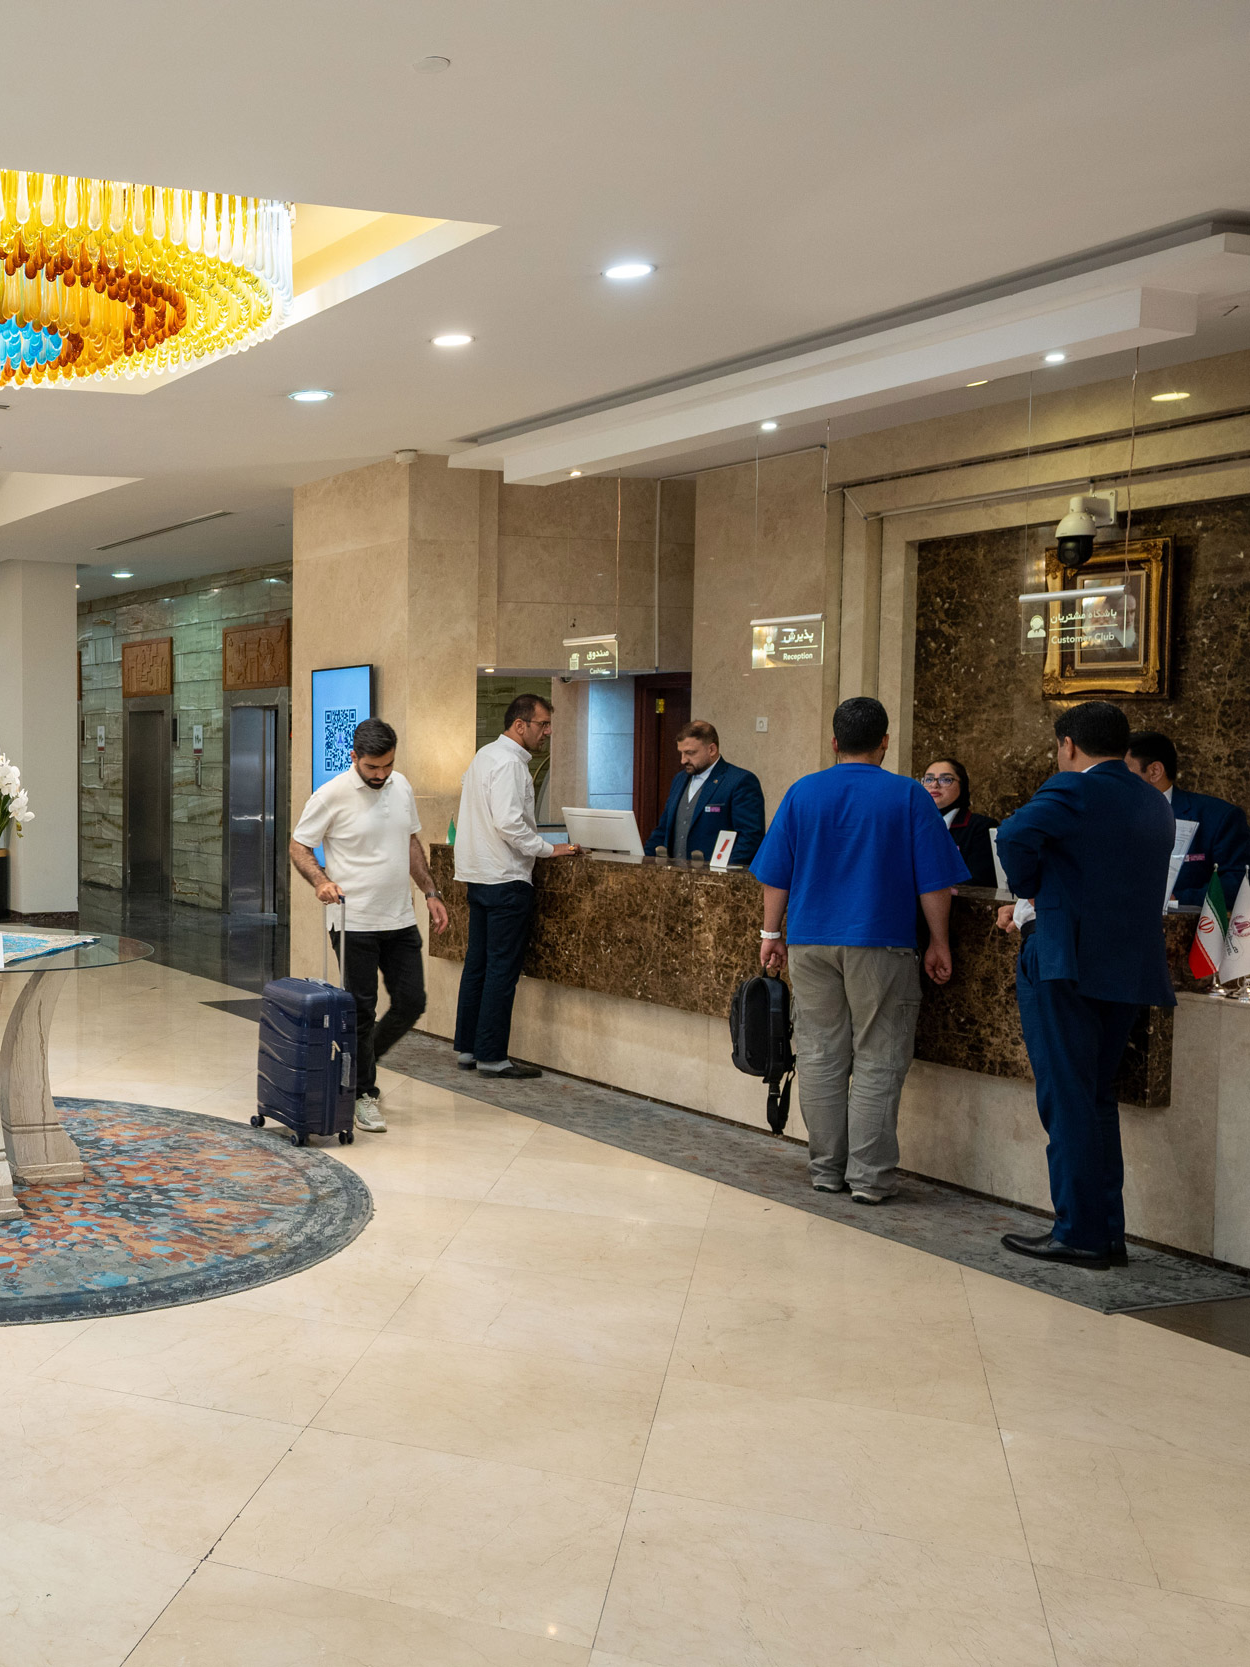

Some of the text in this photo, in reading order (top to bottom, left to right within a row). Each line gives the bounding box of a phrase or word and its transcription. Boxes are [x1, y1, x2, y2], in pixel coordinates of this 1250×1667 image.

[1049, 611, 1086, 624] مشتریان
[783, 629, 814, 643] پذیرش
[1051, 632, 1115, 645] Customer Club
[587, 650, 609, 660] صندوق
[783, 652, 813, 661] Reception
